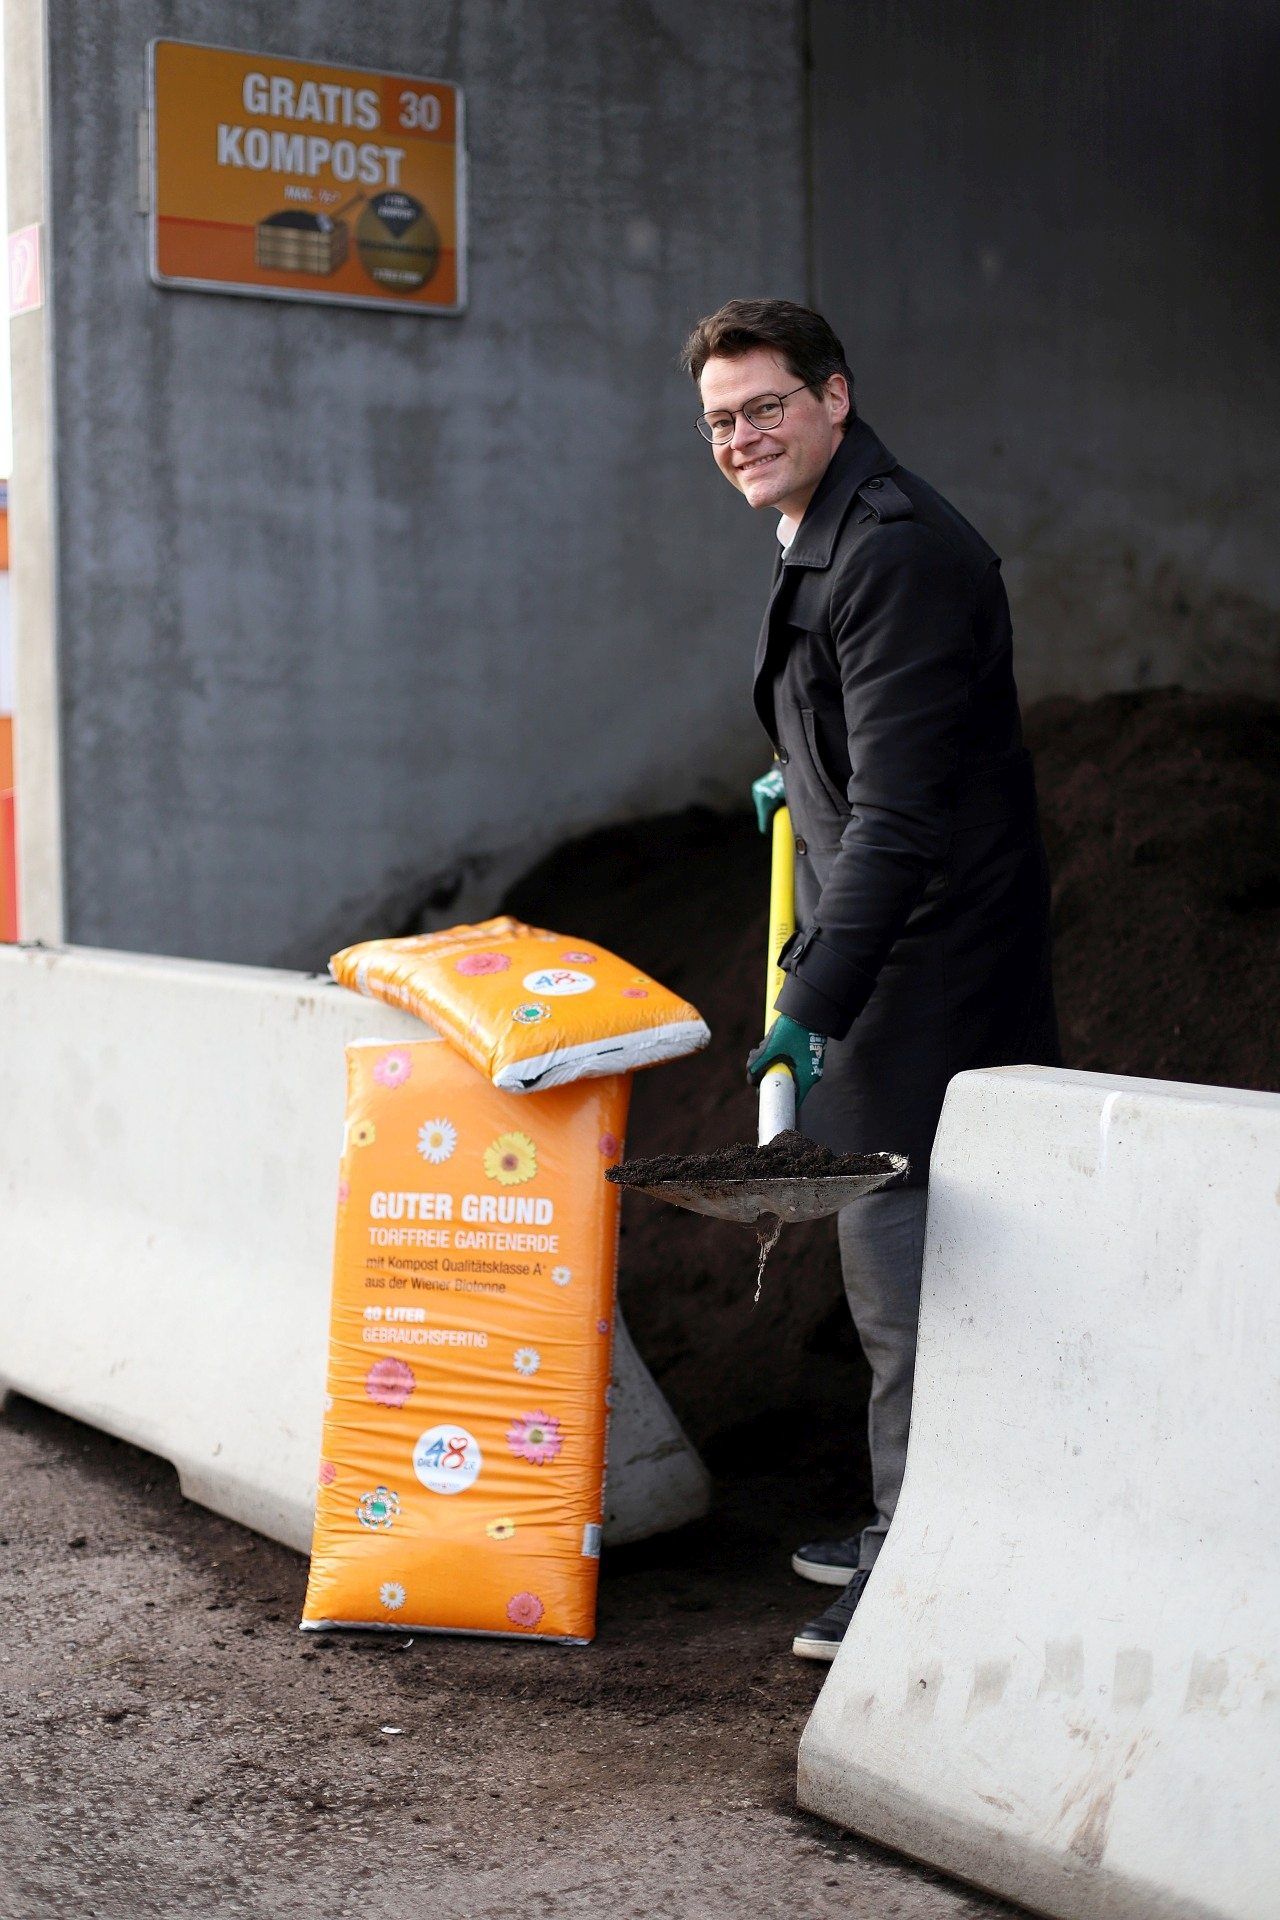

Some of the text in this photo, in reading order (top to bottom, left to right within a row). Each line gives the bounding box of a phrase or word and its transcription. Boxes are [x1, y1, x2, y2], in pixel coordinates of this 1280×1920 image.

[242, 72, 381, 131] GRATIS
[398, 91, 441, 132] 30
[216, 123, 405, 186] KOMPOST
[369, 1191, 554, 1225] GUTER GRUND
[367, 1226, 559, 1254] TORFFREIE GARTENERDE
[366, 1257, 384, 1269] mit
[388, 1256, 438, 1272] Kompost
[441, 1259, 530, 1276] Qualitätsklasse
[364, 1276, 506, 1294] aus der Wiener Biotonne
[385, 1307, 426, 1323] LITER
[362, 1327, 488, 1348] GEBRAUCHSFERTIG
